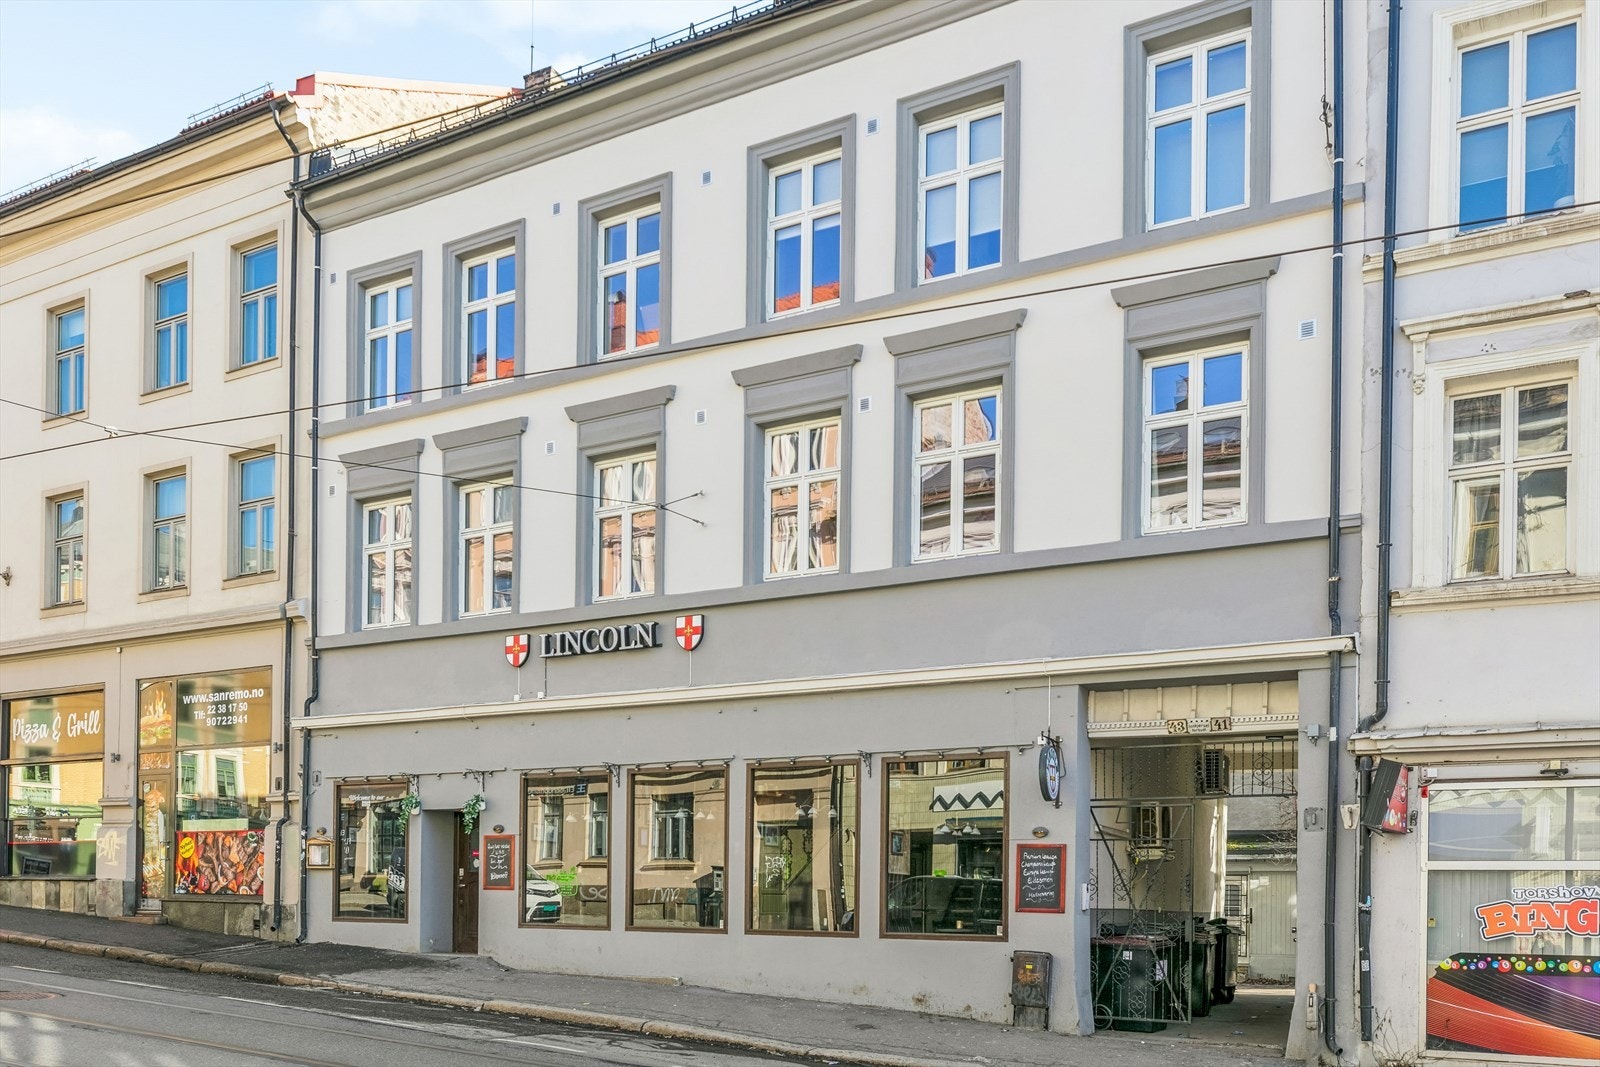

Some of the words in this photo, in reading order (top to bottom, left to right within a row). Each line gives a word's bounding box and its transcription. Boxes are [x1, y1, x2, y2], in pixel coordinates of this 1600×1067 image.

[539, 621, 660, 658] LINCOLN
[183, 688, 264, 704] www.sanremo.no
[207, 705, 216, 714] 22
[218, 704, 227, 713] 38
[228, 703, 237, 712] 17
[239, 702, 248, 711] 50
[194, 710, 206, 719] Tlf:
[206, 714, 248, 726] 90722941
[12, 718, 49, 744] Pizza
[52, 712, 62, 743] &
[67, 709, 101, 737] Grill
[1169, 721, 1185, 732] 43
[1214, 719, 1229, 730] 41
